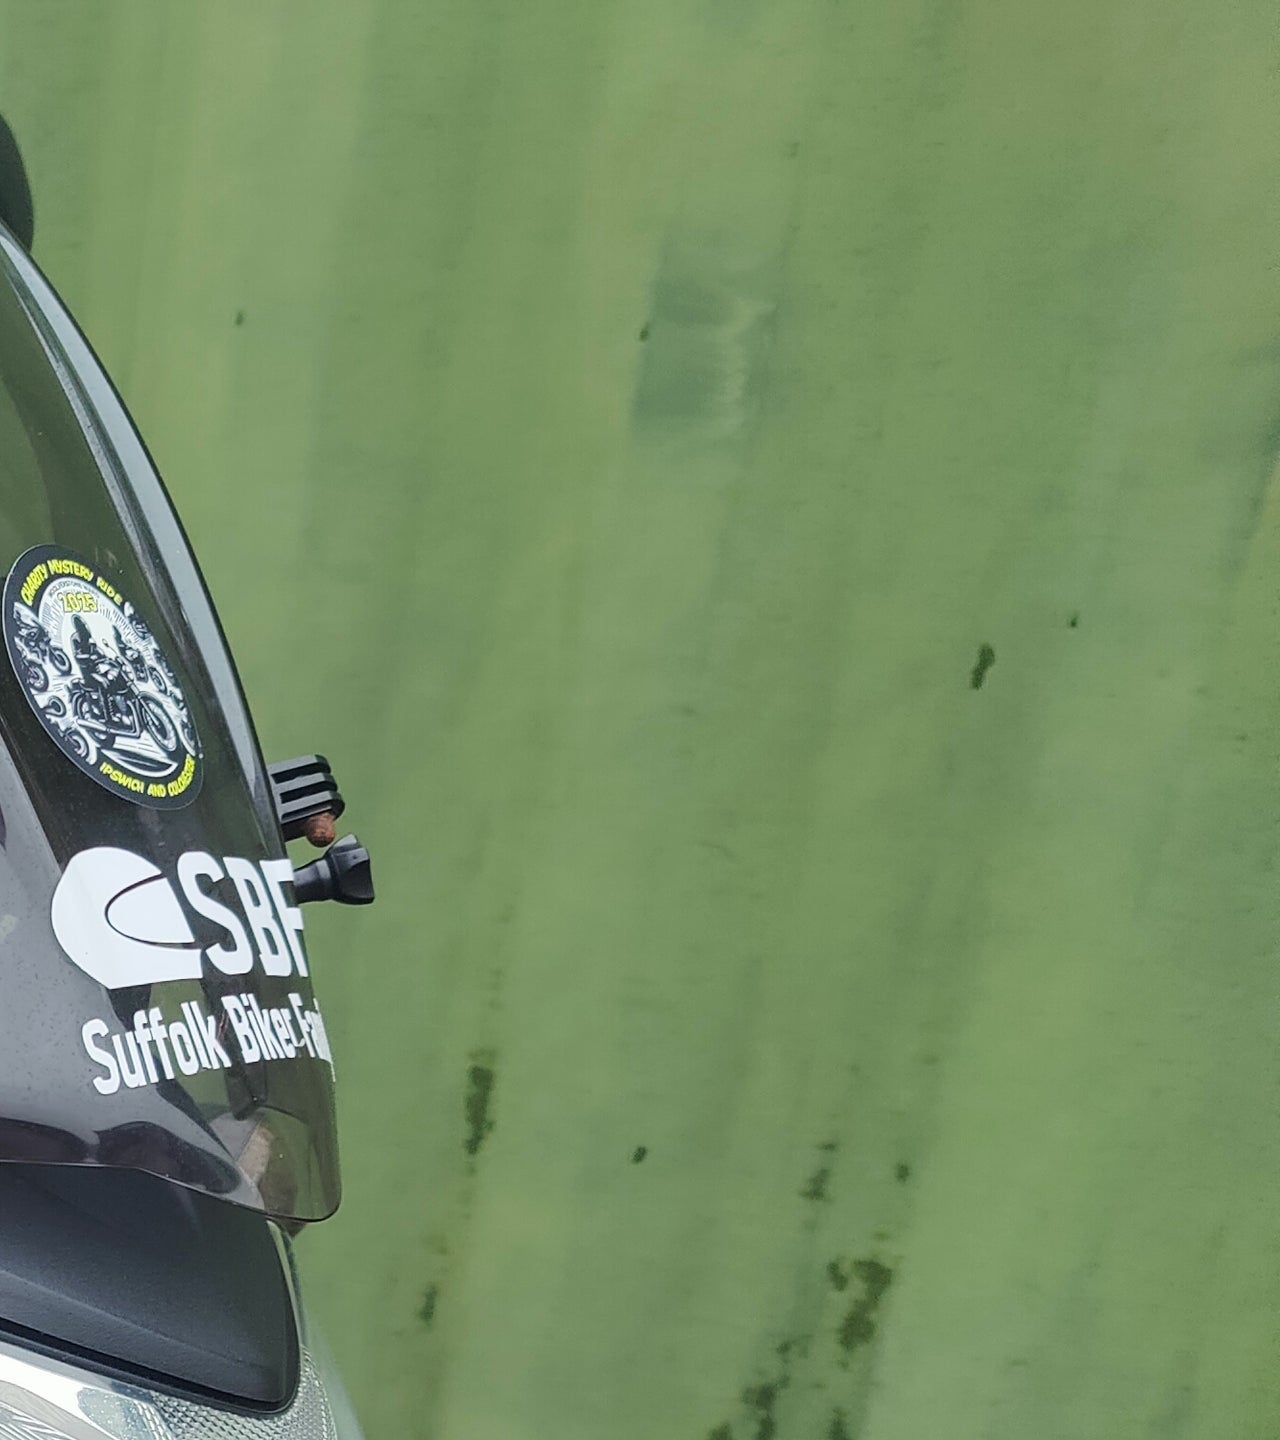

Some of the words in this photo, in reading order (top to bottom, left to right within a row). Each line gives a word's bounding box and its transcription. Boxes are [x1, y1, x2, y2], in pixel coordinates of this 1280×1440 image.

[21, 563, 48, 607] CHARITY
[46, 559, 94, 581] MYSTERY
[96, 576, 123, 606] RIDE
[57, 591, 98, 613] 2025
[100, 762, 144, 793] IPSWICH
[147, 783, 166, 798] AND
[177, 851, 308, 978] SBF
[81, 1001, 232, 1095] Suffolk
[220, 993, 306, 1064] Biker
